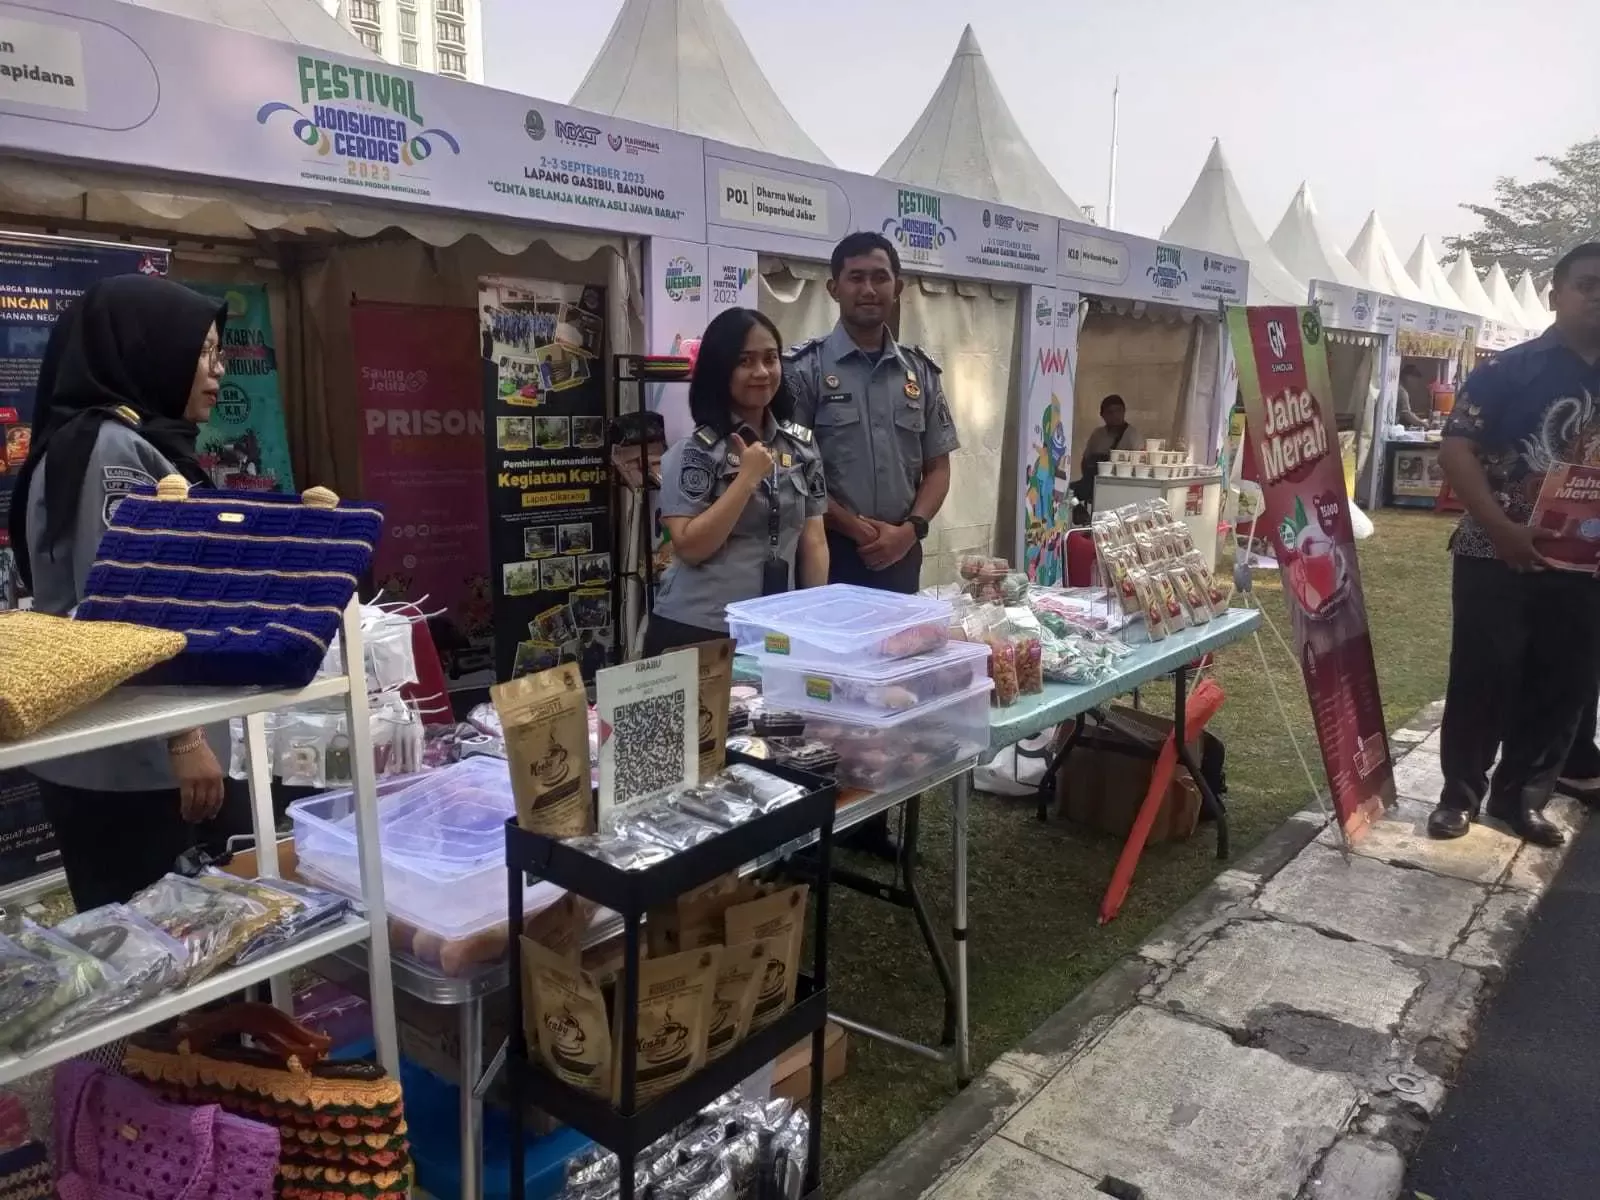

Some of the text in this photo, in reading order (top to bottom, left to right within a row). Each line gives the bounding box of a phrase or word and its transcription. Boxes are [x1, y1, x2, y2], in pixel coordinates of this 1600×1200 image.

[297, 55, 424, 127] FESTIVAL
[313, 105, 407, 143] KONSUMEN
[334, 132, 400, 165] CERDAS
[347, 160, 391, 181] 2023
[540, 156, 645, 185] 2-3 SEPTEMBER 2023
[524, 166, 665, 201] LAPANG GASIBU, BANDUNG
[726, 187, 749, 205] P01
[756, 186, 812, 206] Dharma Wanita
[528, 186, 573, 204] BELANJA
[574, 193, 607, 210] KARYA
[607, 198, 627, 213] ASLI
[628, 201, 653, 216] JAWA
[897, 189, 943, 226] FESTIVAL
[902, 218, 937, 236] KONSUMEN
[909, 233, 933, 250] CERDAS
[1156, 246, 1181, 268] FESTIVAL
[713, 289, 737, 304] 2023
[361, 366, 405, 381] Saung
[365, 408, 485, 436] PRISON
[1265, 387, 1313, 436] Jahe
[1261, 416, 1328, 481] Merah
[503, 459, 549, 469] Pembinaan
[498, 470, 566, 489] Kegiatan
[569, 467, 607, 484] Kerja
